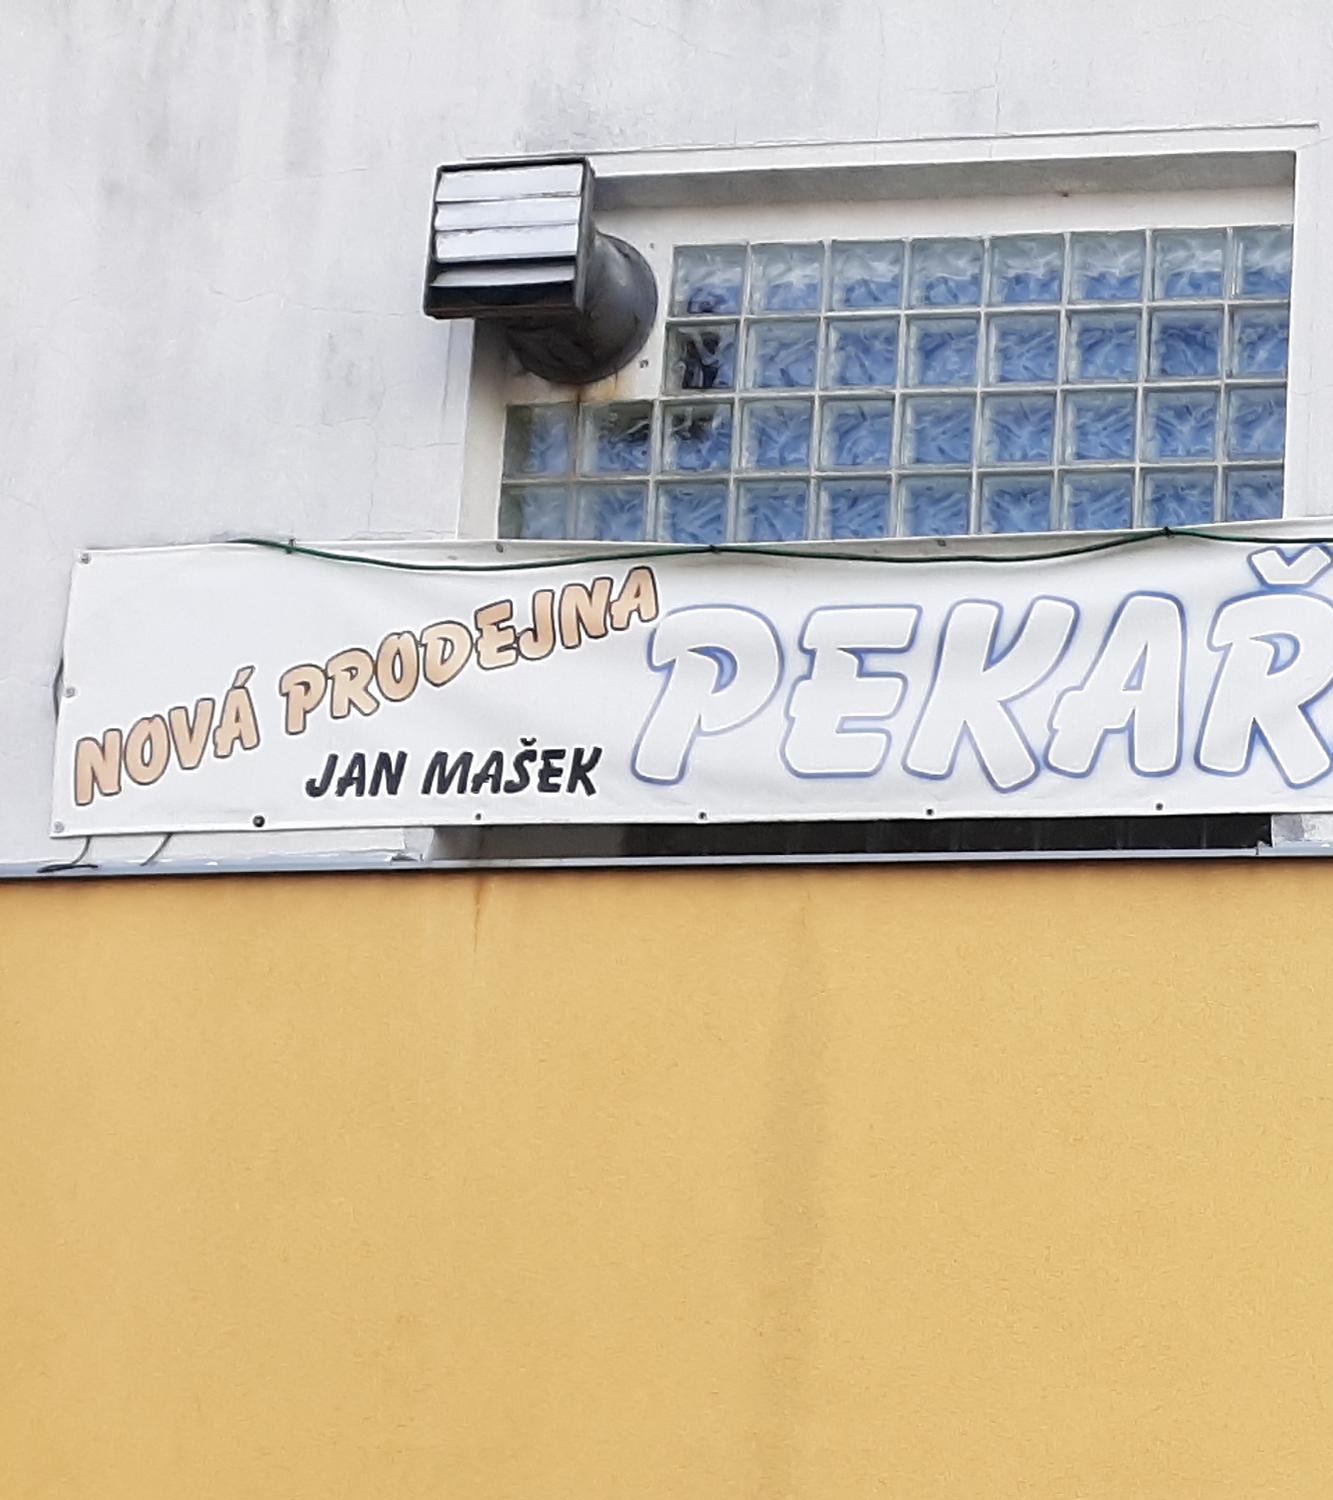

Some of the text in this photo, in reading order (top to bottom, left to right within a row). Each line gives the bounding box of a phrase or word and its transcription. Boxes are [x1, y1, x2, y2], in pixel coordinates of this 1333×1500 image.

[73, 566, 661, 805] NOVÁ PRODEJNA
[305, 737, 603, 798] JAN MAŠEK
